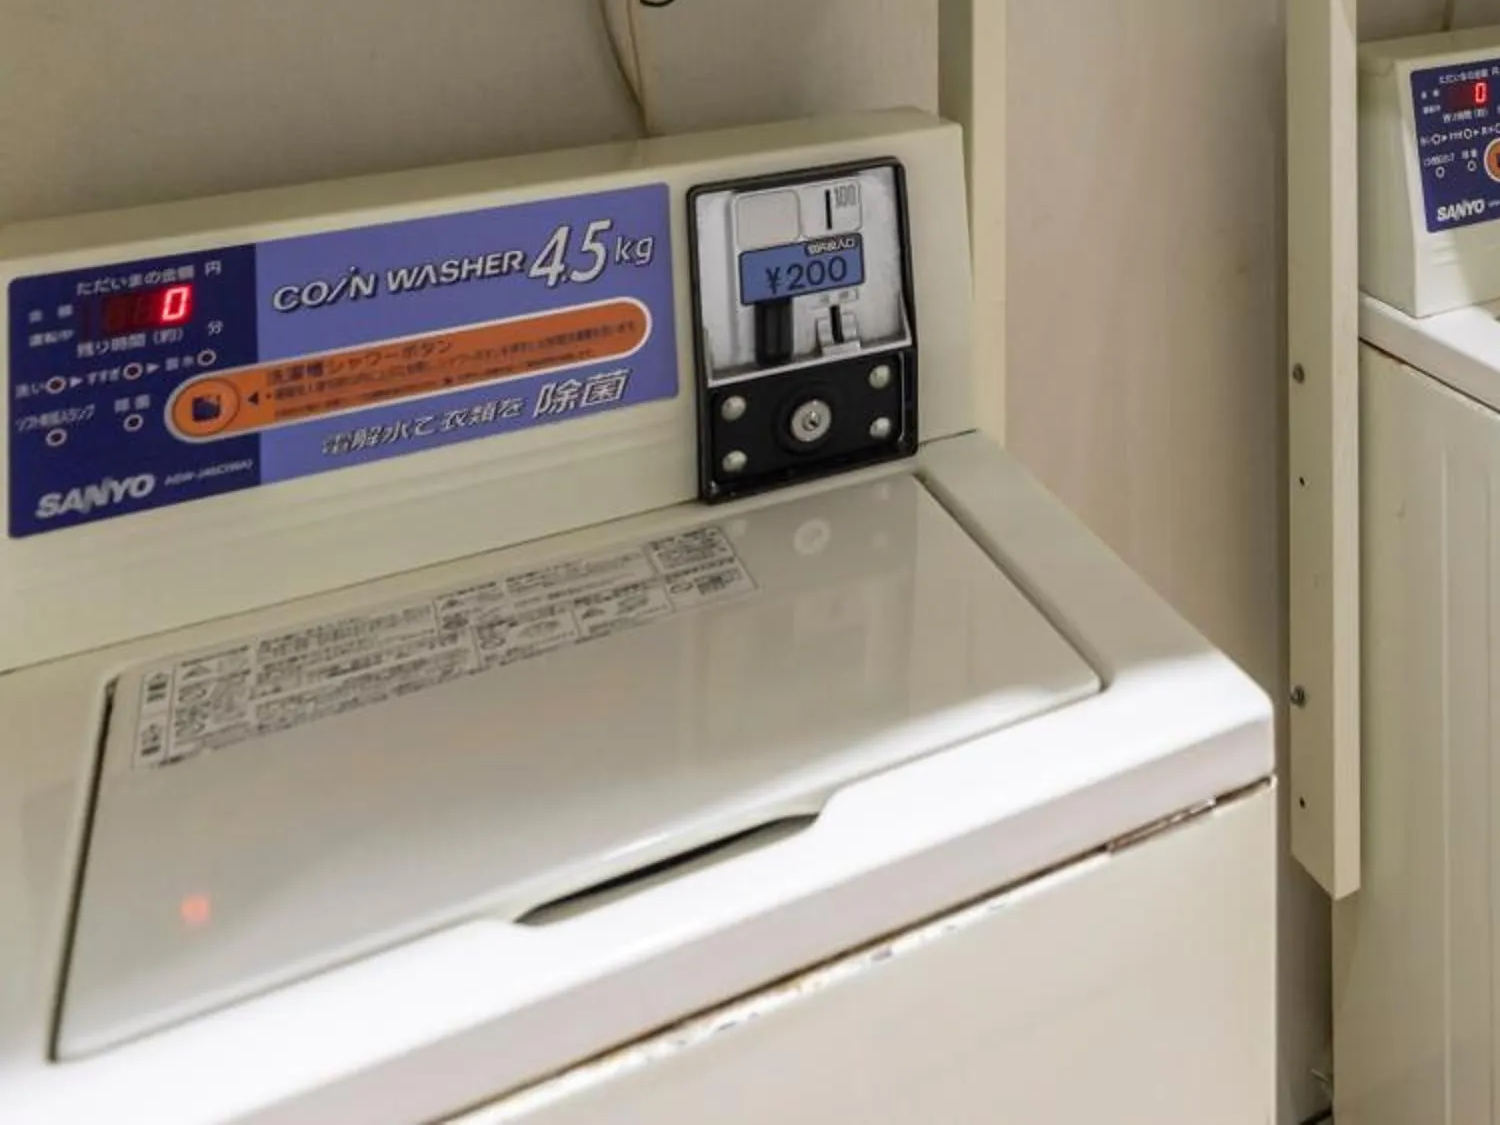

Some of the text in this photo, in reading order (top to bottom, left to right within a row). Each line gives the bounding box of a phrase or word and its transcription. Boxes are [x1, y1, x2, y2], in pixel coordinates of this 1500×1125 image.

[1475, 82, 1487, 104] 0
[1436, 197, 1486, 222] SANYO
[386, 248, 526, 293] WASHER
[614, 234, 656, 266] kg
[766, 256, 847, 294] ¥200
[161, 286, 190, 323] 0
[35, 474, 156, 520] SANYO
